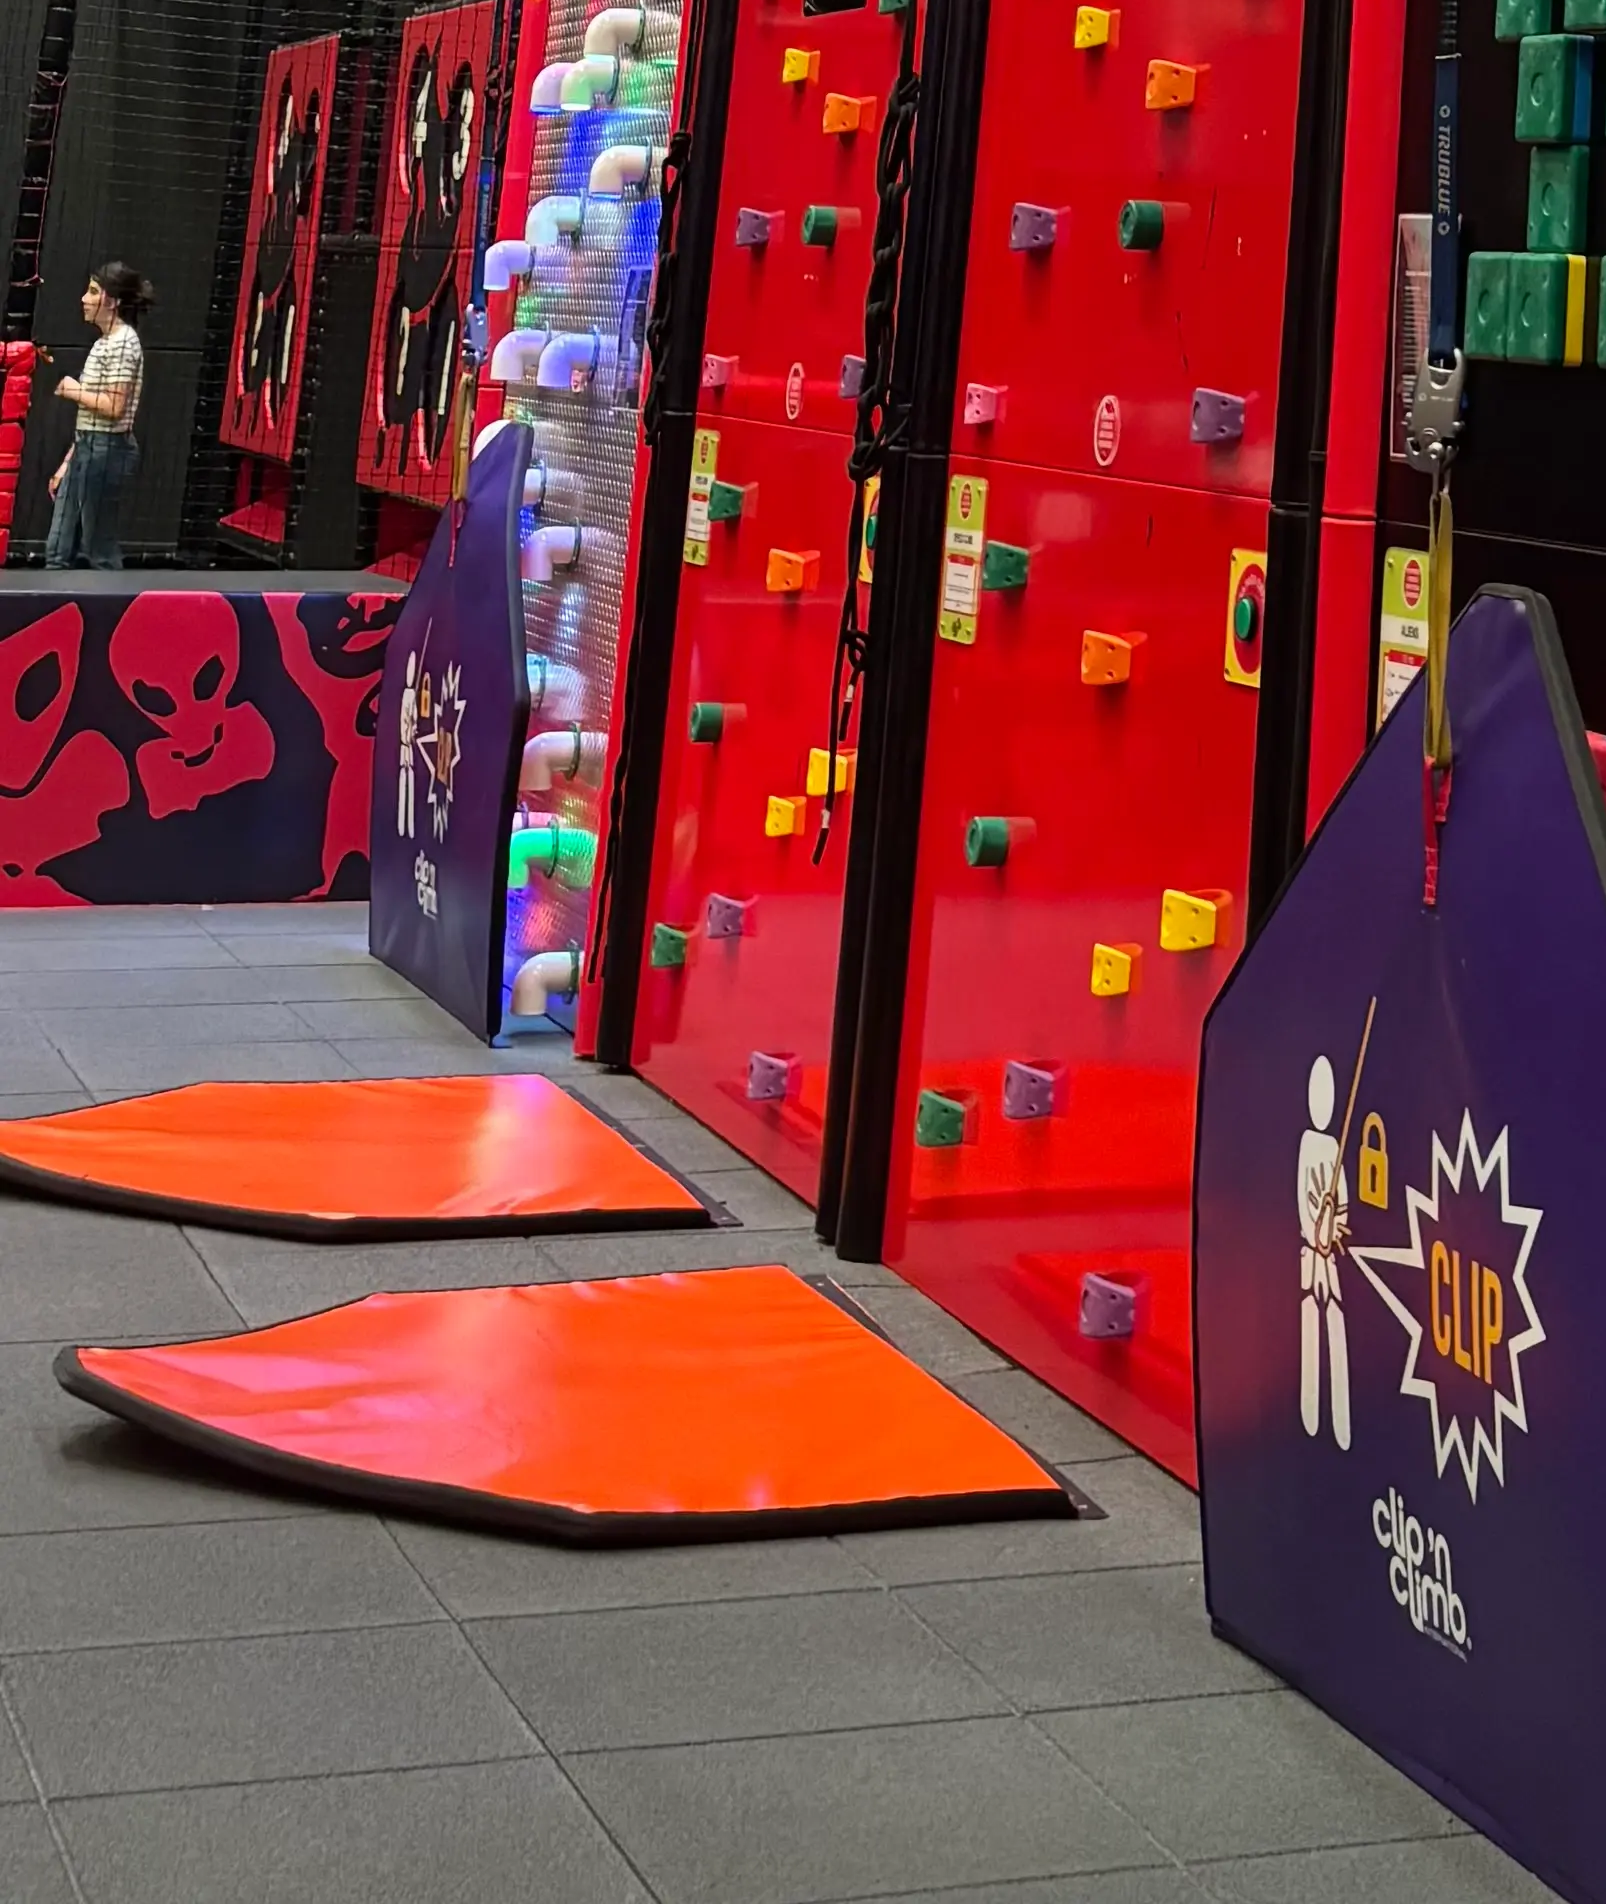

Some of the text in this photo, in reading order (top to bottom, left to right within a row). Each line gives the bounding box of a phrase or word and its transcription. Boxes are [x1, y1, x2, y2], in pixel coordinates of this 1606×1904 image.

[1438, 125, 1451, 217] TRUBLUE
[1431, 1240, 1503, 1385] CLIP
[1372, 1486, 1425, 1570] clip
